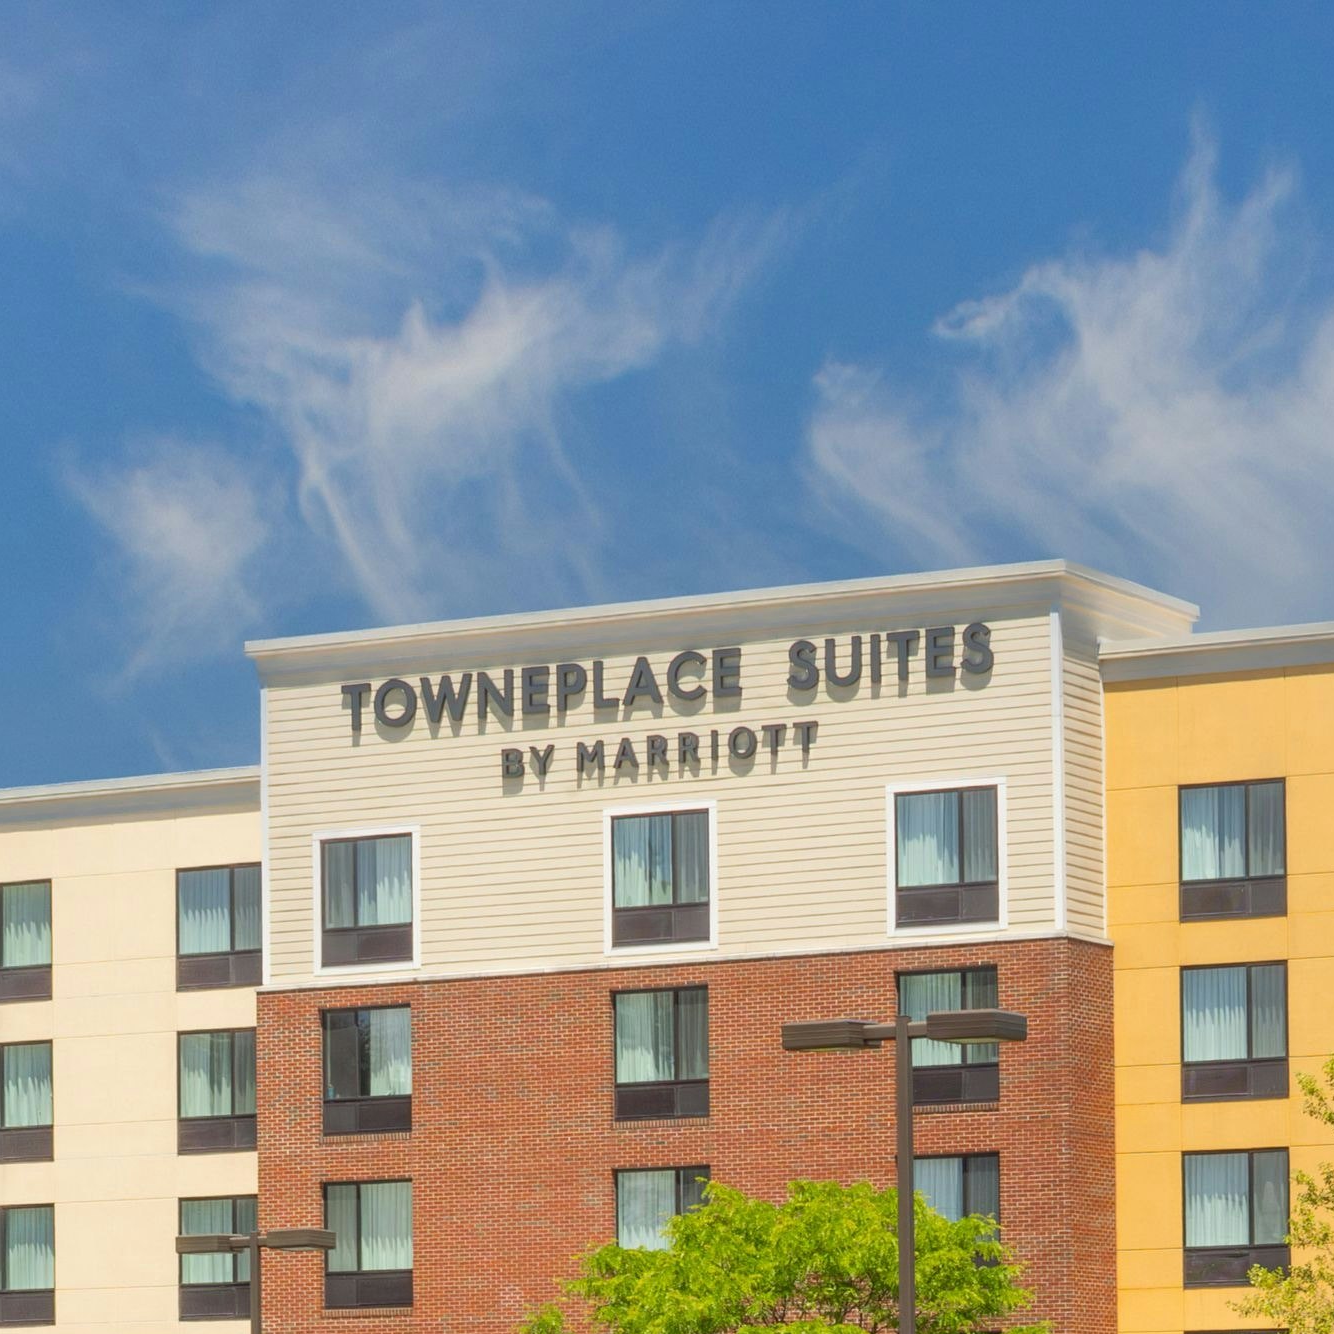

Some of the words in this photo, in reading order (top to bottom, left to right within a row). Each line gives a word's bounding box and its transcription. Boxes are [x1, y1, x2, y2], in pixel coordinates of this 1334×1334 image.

[341, 648, 742, 731] TOWNEPLACE
[787, 622, 994, 690] SUITES
[502, 744, 554, 778] BY
[577, 721, 818, 772] MARRIOTT
